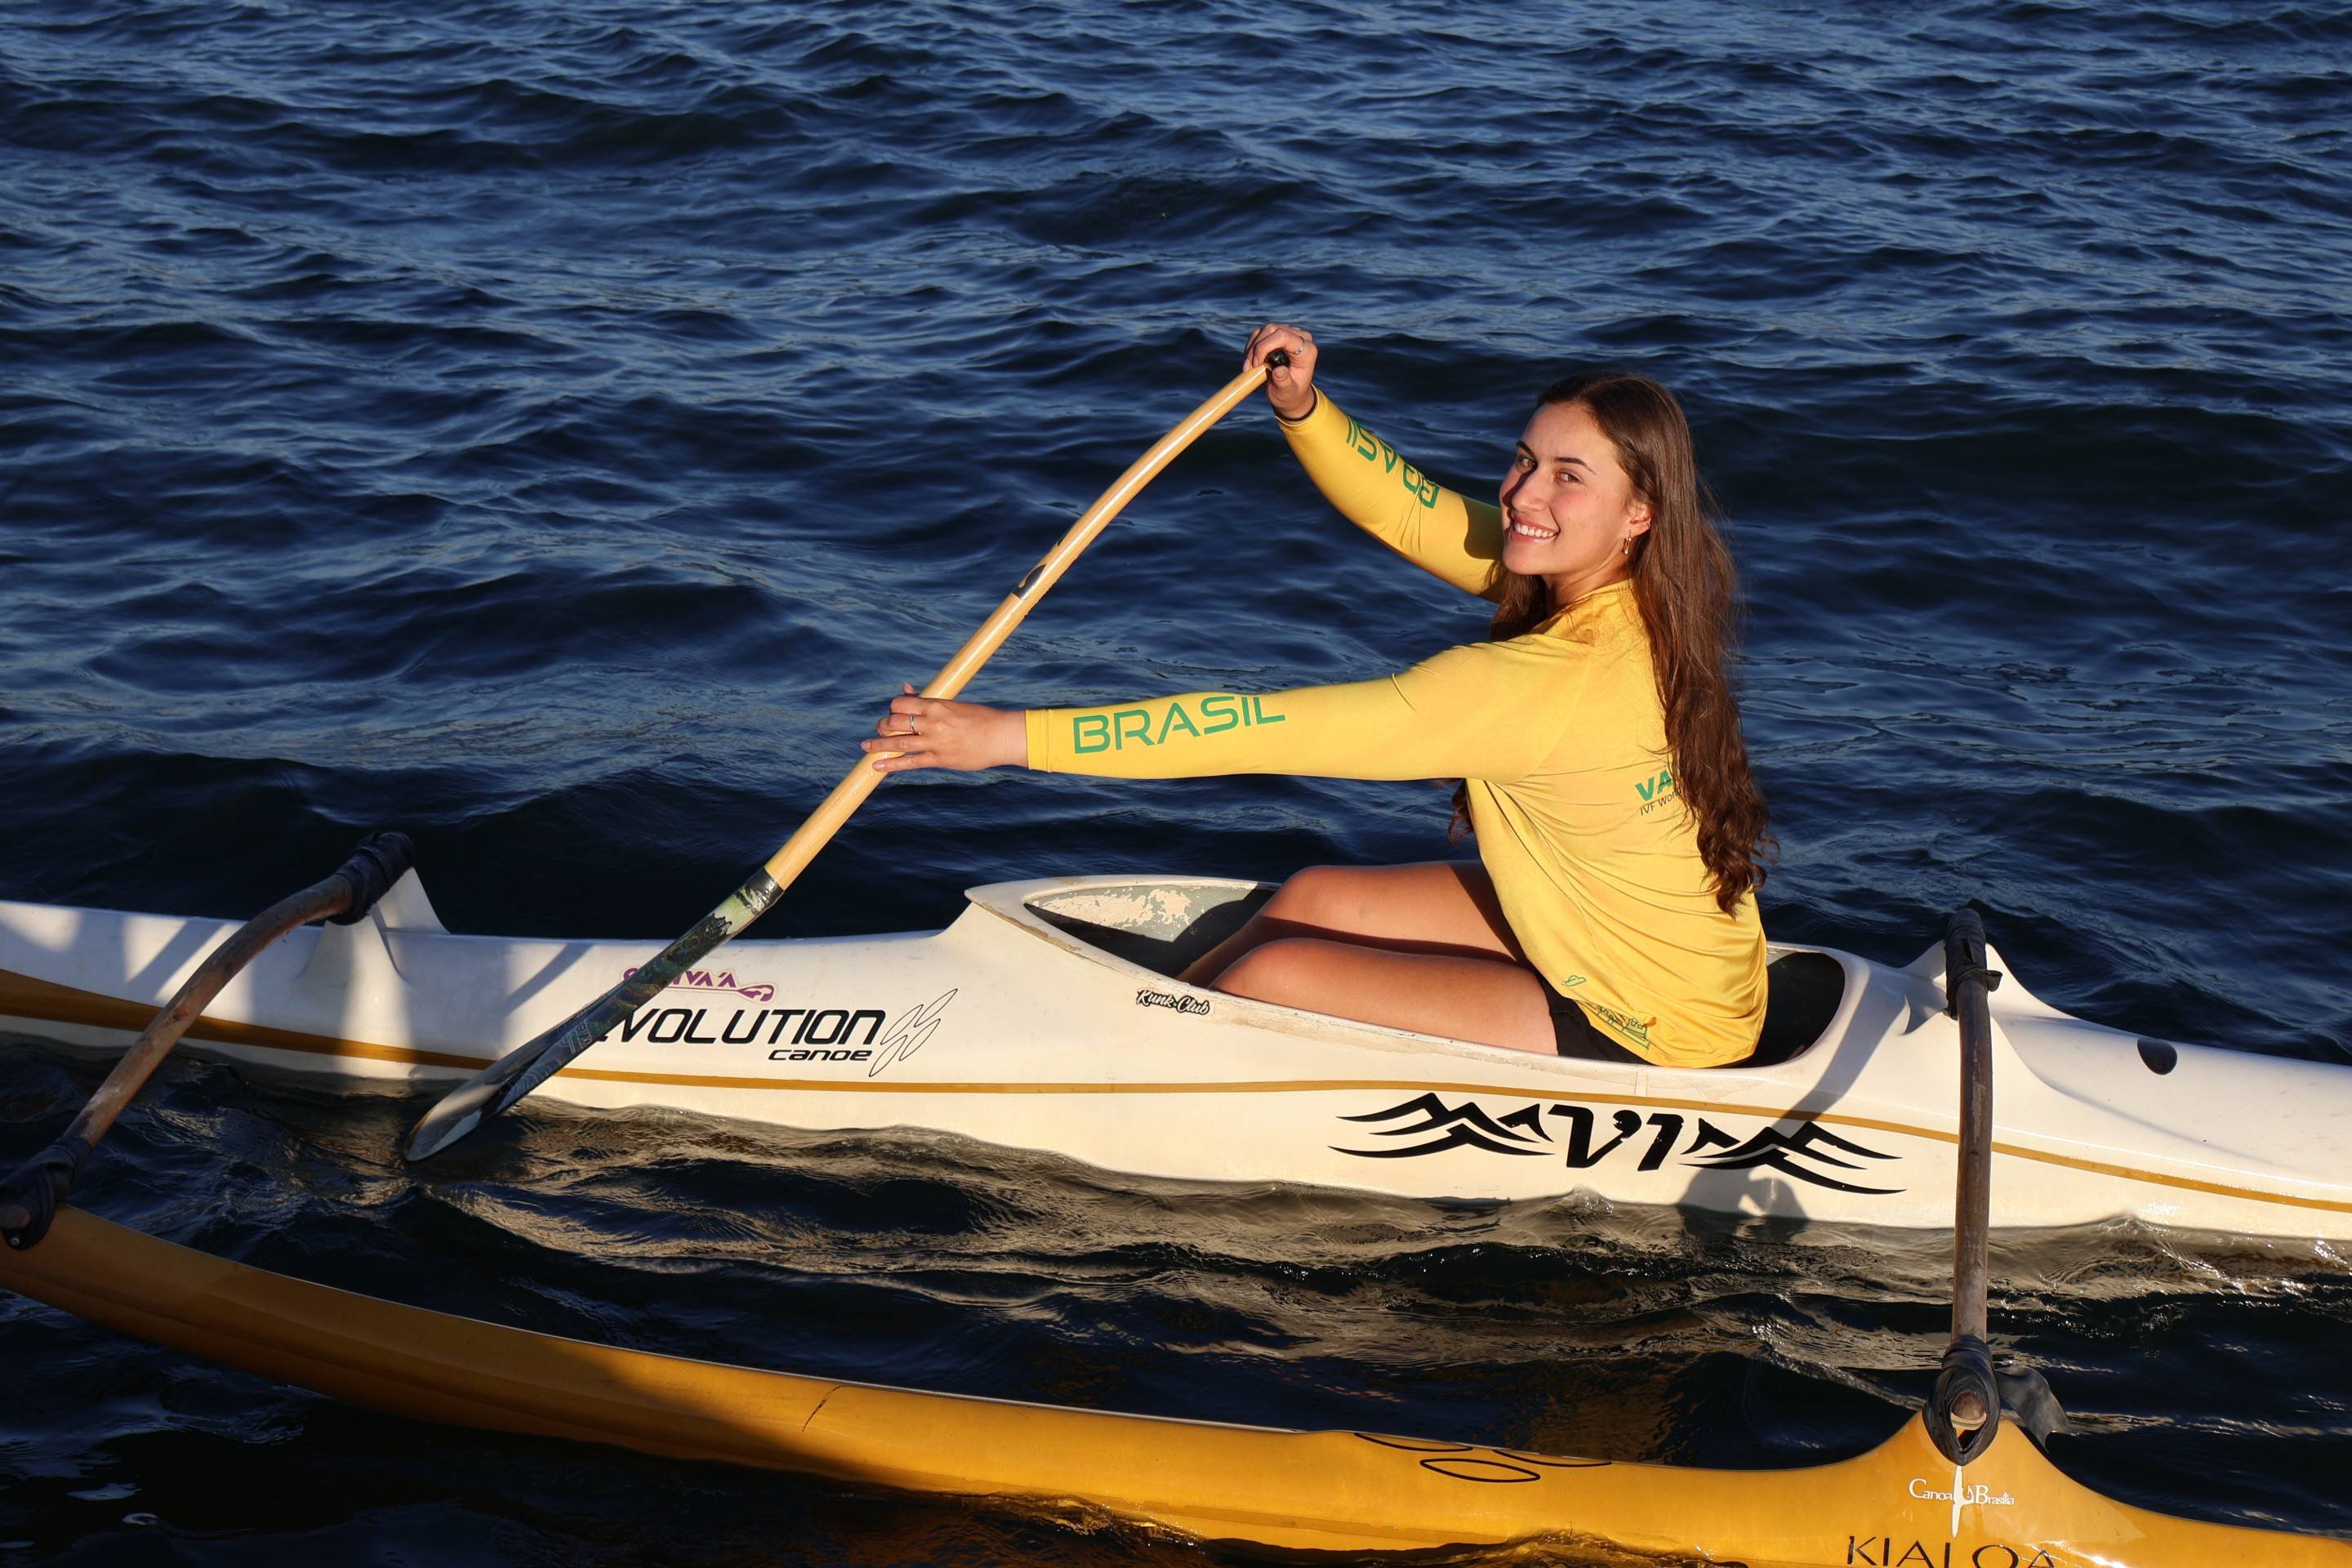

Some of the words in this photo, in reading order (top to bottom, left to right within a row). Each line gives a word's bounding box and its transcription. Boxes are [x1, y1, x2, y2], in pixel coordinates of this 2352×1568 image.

[1072, 696, 1285, 754] BRASIL
[598, 1009, 886, 1045] VOLUTION
[768, 1049, 872, 1061] canoe
[1909, 1478, 1953, 1501] Canoa
